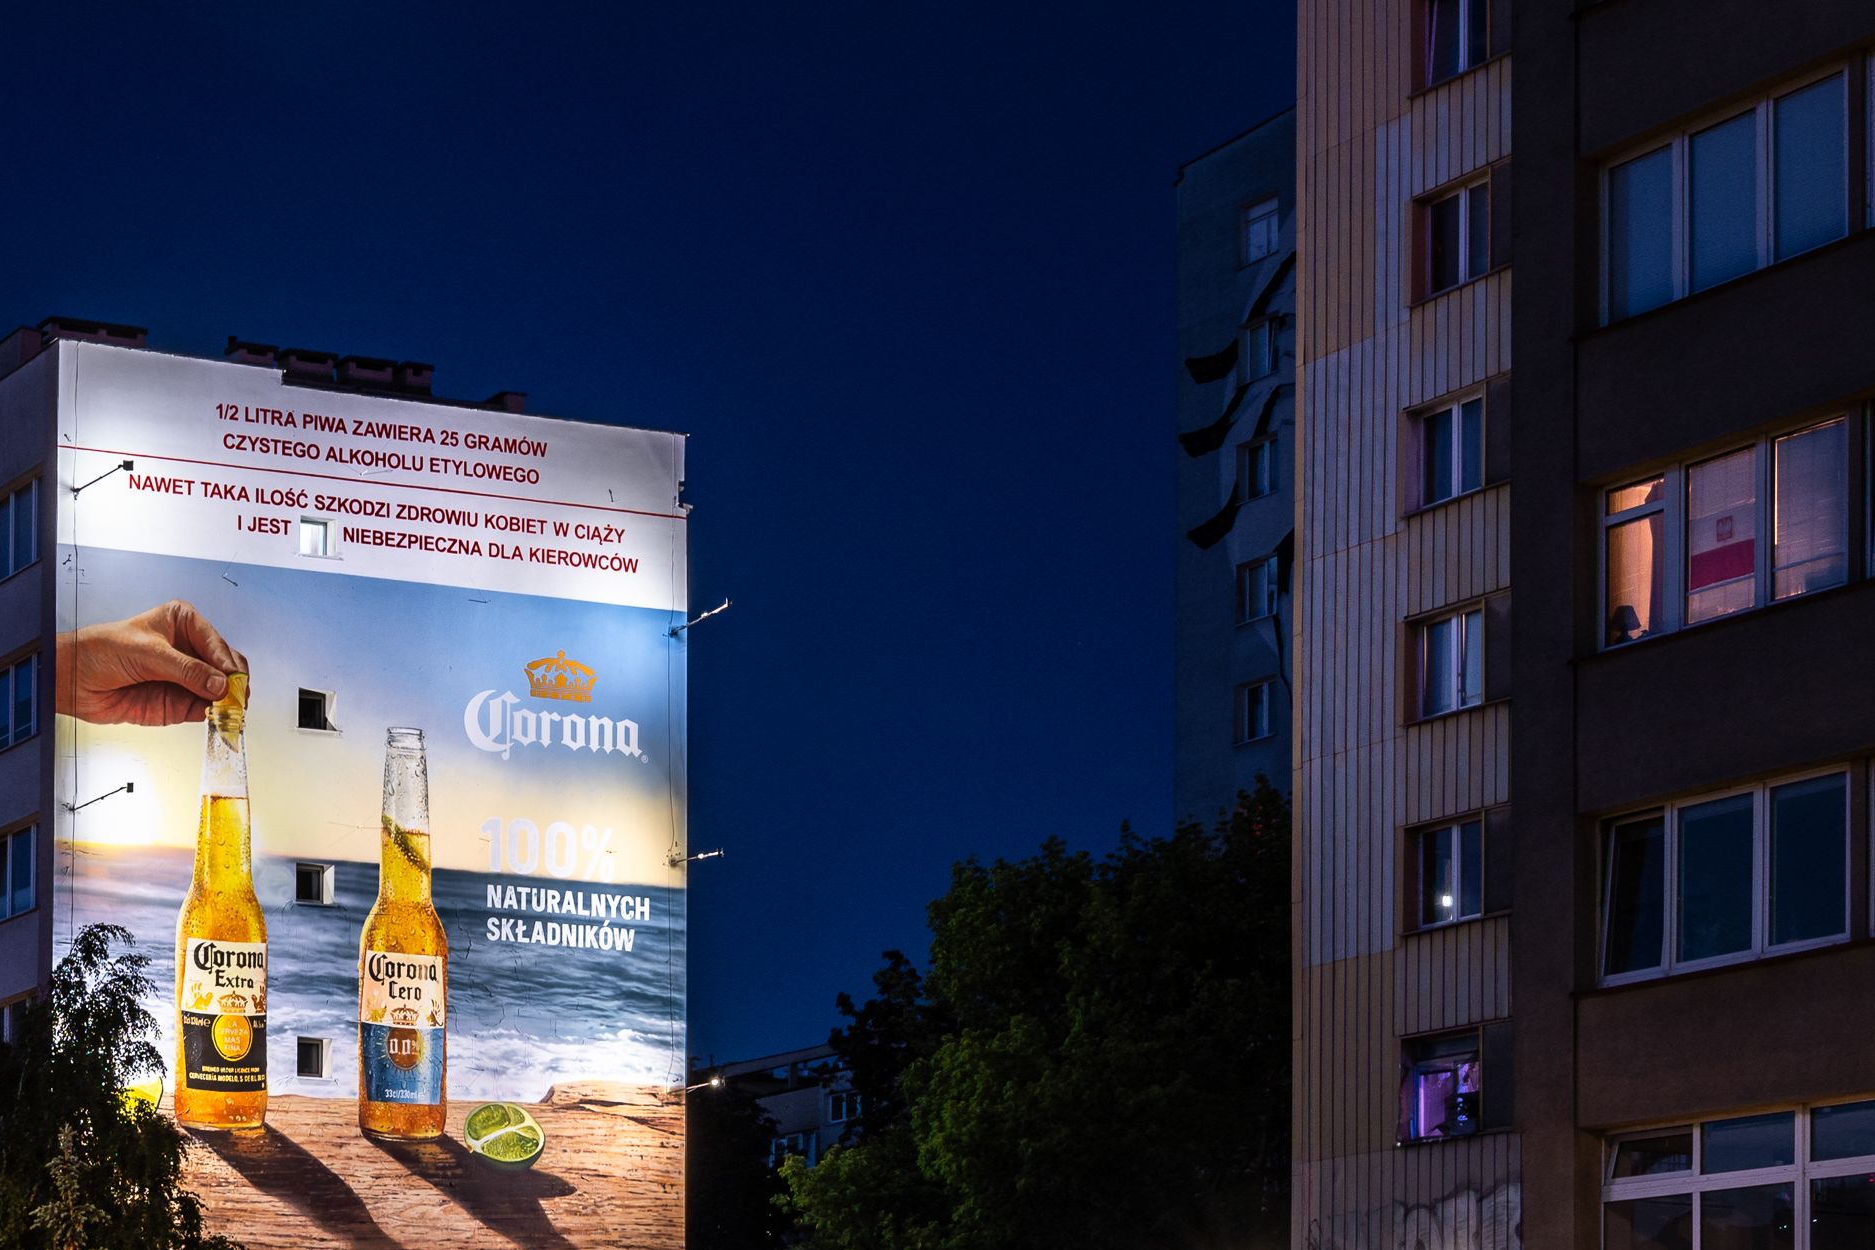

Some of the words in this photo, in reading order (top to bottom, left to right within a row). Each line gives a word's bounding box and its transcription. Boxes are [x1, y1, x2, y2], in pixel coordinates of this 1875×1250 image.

[215, 403, 239, 421] 1/2
[244, 407, 297, 428] LITRA
[302, 414, 348, 434] PIWA
[352, 420, 436, 444] ZAWIERA
[440, 430, 459, 447] 25
[464, 433, 548, 458] GRAMÓW
[223, 433, 321, 460] CZYSTEGO
[325, 446, 424, 472] ALKOHOLU
[429, 457, 540, 485] ETYLOWEGO
[128, 474, 195, 496] NAWET
[201, 481, 250, 502] TAKA
[255, 488, 309, 509] ILOŚĆ
[314, 494, 391, 518] SZKODZI
[396, 504, 479, 528] ZDROWIU
[484, 514, 548, 535] KOBIET
[553, 521, 570, 538] W
[575, 524, 626, 546] CIĄŻY
[237, 515, 242, 530] I
[247, 516, 292, 536] JEST
[343, 527, 482, 556] NIEBEZPIECZNA
[488, 543, 524, 561] DLA
[529, 547, 639, 574] KIEROWCÓW
[463, 688, 643, 761] Corona
[480, 816, 616, 883] 100%
[486, 884, 651, 921] NATURALNYCH
[486, 917, 636, 952] SKŁADNIKÓW
[193, 942, 264, 974] Corona
[214, 969, 254, 989] Extra
[368, 953, 438, 985] Corona
[388, 980, 422, 1001] Cero
